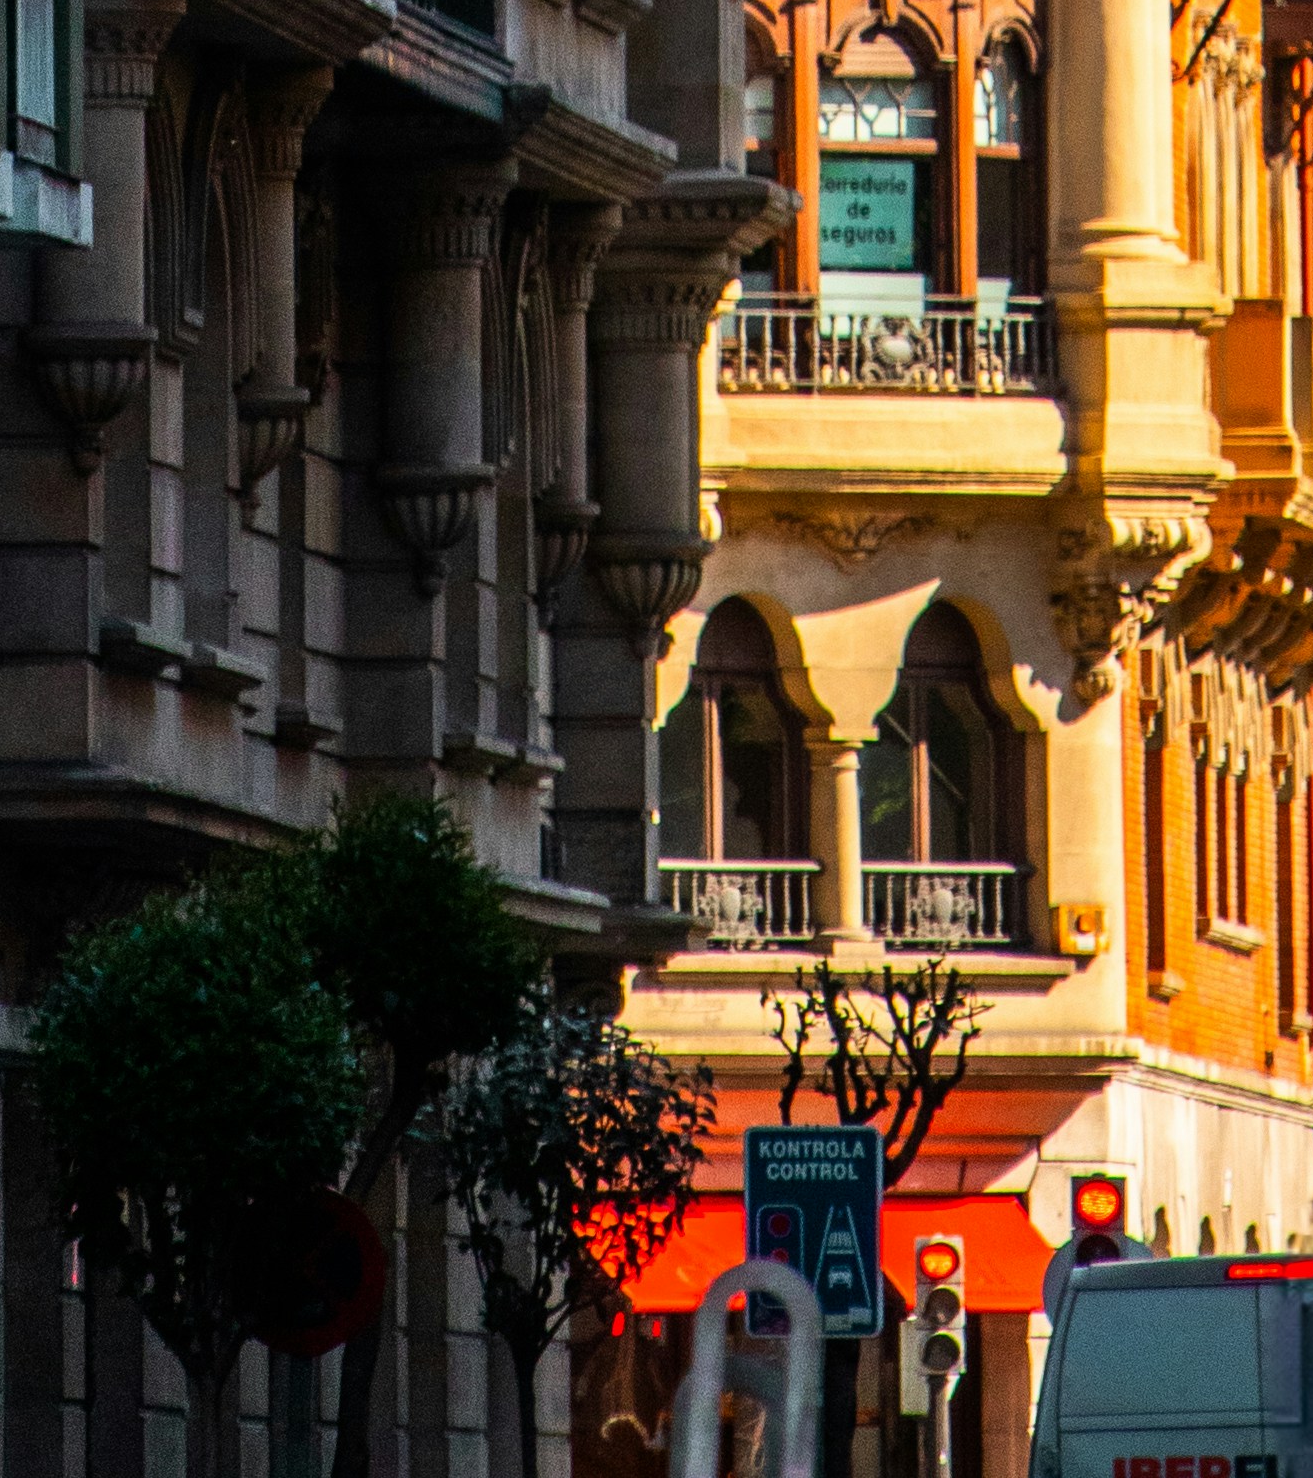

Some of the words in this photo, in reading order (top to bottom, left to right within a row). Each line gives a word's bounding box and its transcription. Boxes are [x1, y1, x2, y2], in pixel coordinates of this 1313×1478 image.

[820, 173, 907, 195] orreduría
[847, 200, 870, 220] de
[820, 227, 896, 248] seguros
[758, 1140, 866, 1159] KONTROLA
[766, 1163, 859, 1181] CONTROL
